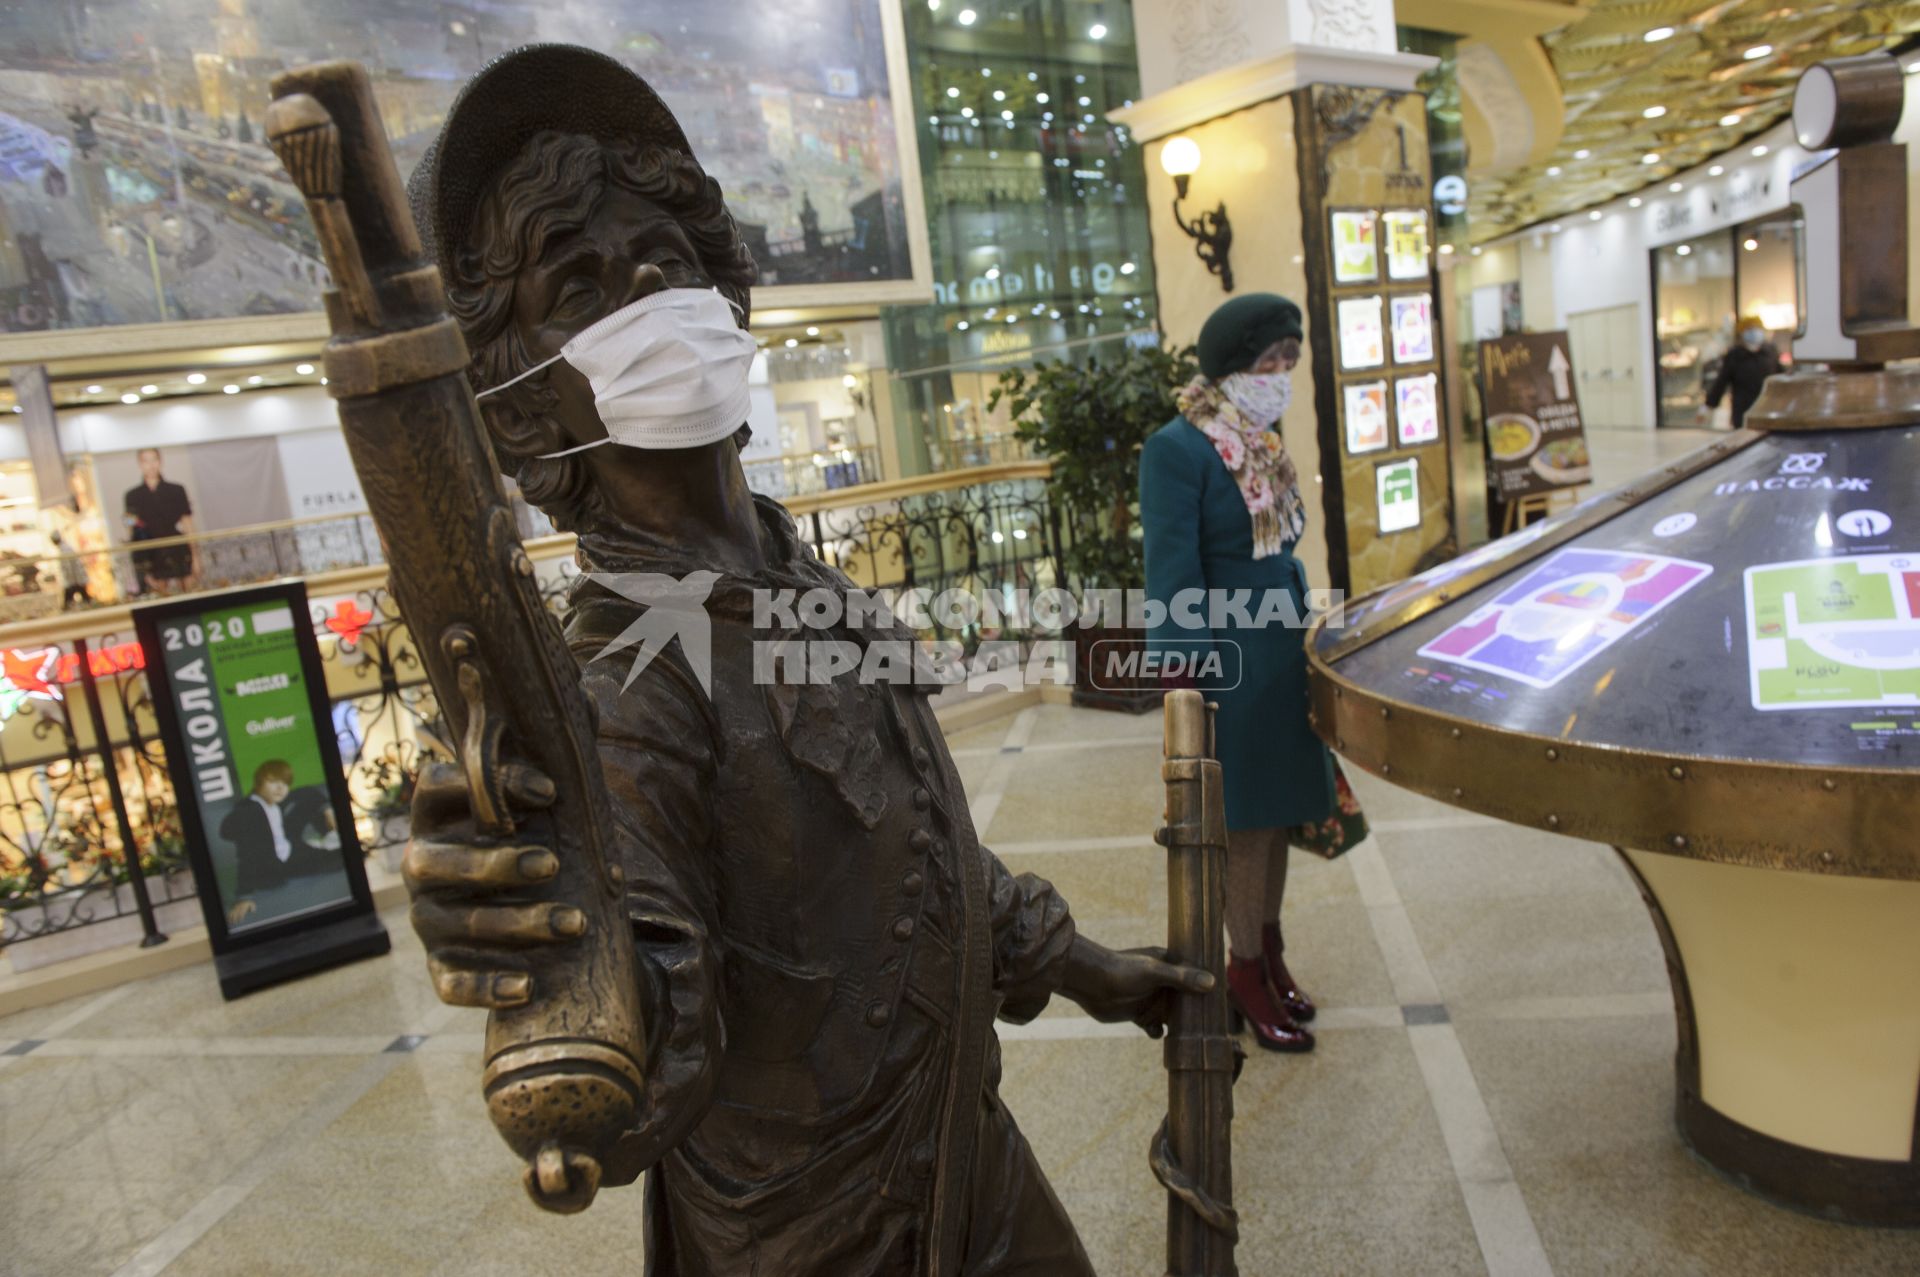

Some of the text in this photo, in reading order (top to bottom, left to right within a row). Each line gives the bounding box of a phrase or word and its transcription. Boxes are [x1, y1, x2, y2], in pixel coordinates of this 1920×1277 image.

[1714, 476, 1873, 495] ПАССАЖ
[164, 616, 246, 651] 2020
[174, 657, 234, 803] ШКОЛА
[246, 715, 296, 736] Gulliver
